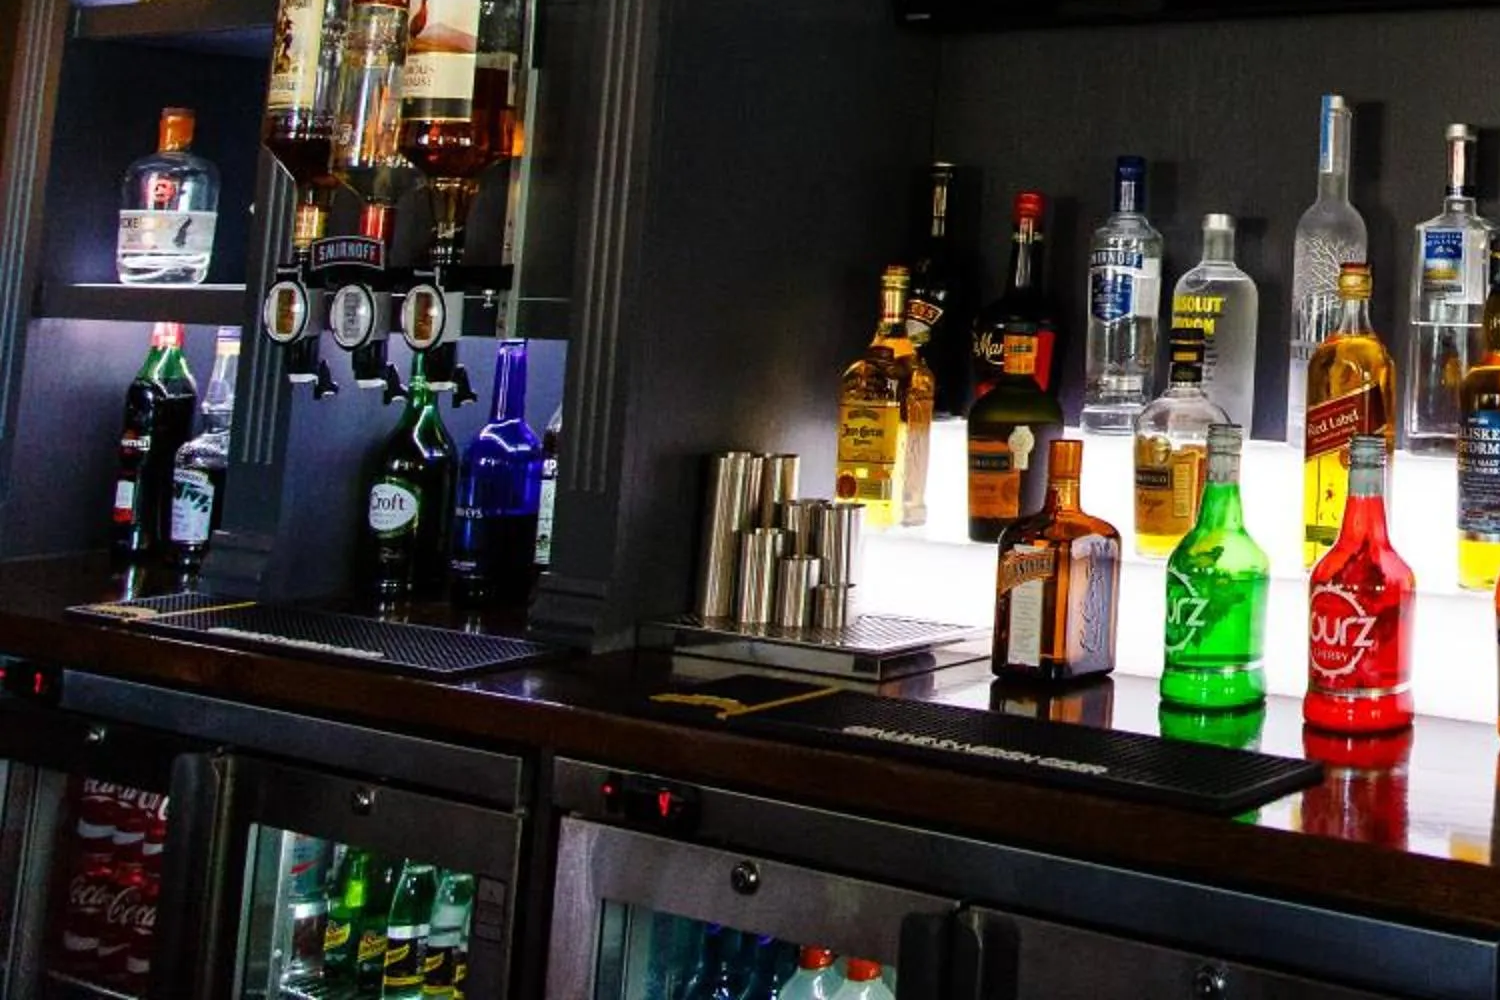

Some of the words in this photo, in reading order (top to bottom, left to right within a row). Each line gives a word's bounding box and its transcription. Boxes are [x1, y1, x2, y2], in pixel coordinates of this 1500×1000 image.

[319, 241, 376, 262] SMIRNOFF
[1307, 420, 1330, 438] Red
[1330, 409, 1360, 430] Label
